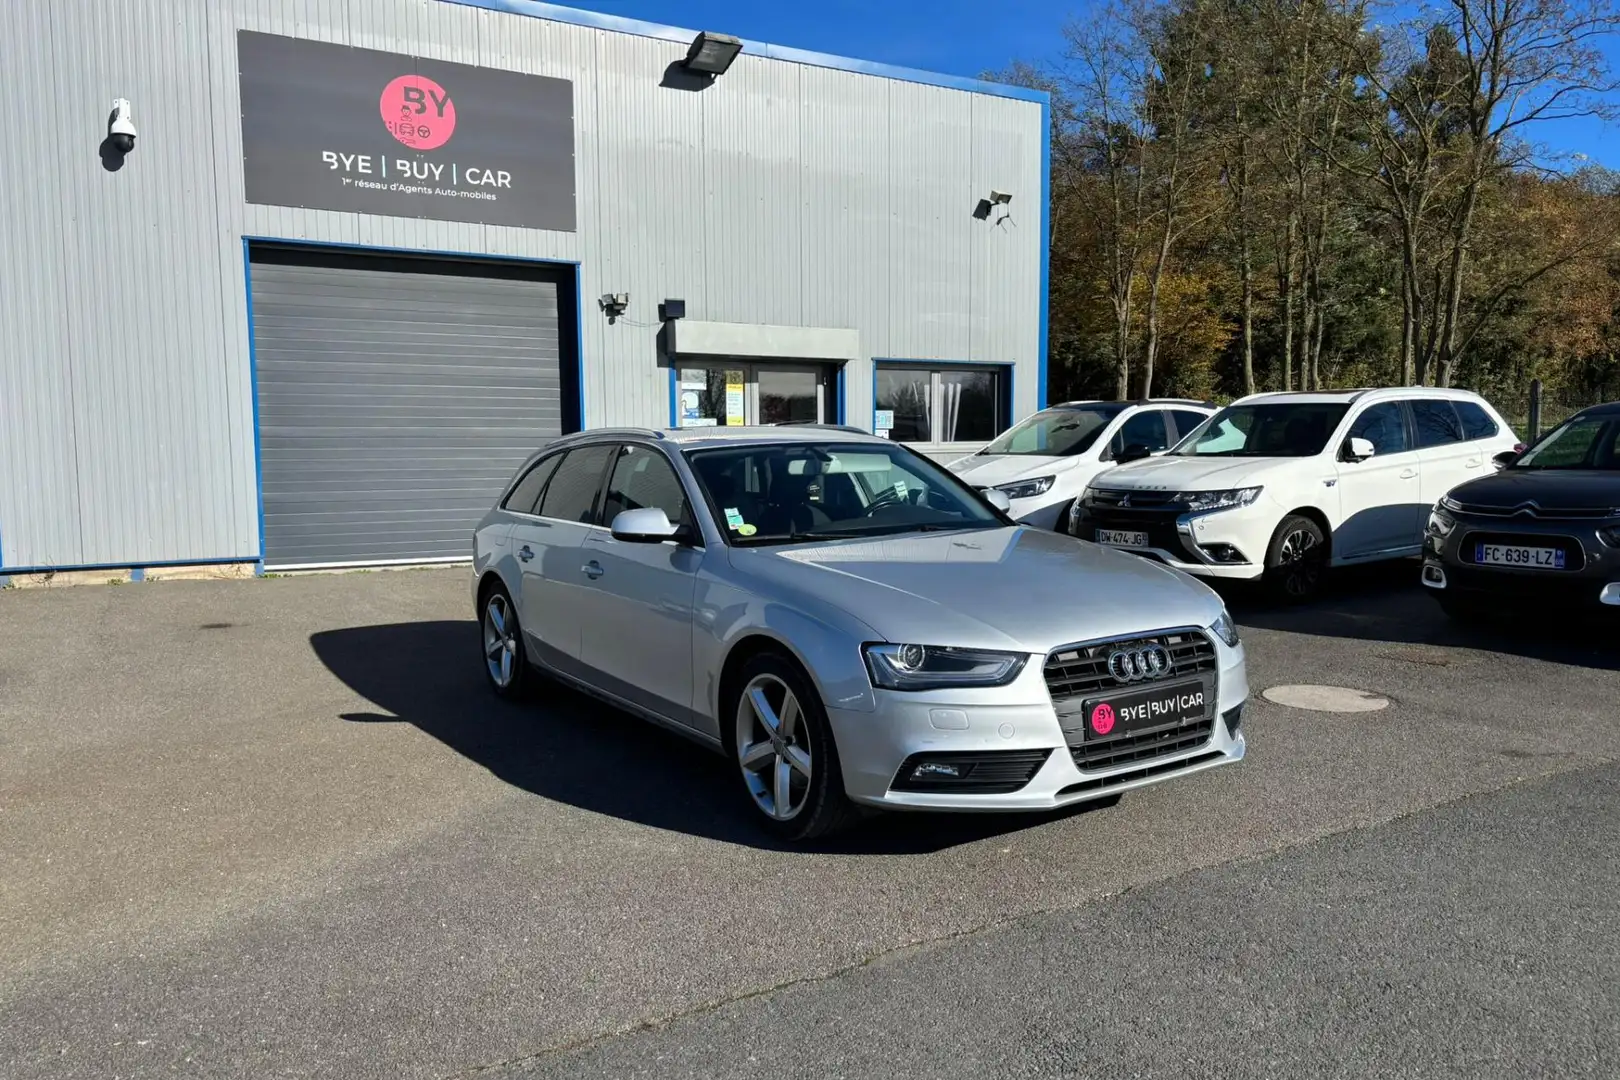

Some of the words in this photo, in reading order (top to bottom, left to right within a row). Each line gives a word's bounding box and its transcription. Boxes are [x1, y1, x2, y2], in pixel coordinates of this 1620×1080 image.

[403, 86, 450, 117] BY
[322, 151, 372, 173] BYE
[396, 159, 444, 181] BUY
[465, 167, 511, 188] CAR
[354, 180, 387, 190] réseau
[390, 182, 432, 195] d'Agents
[434, 187, 497, 201] Auto-mobiles
